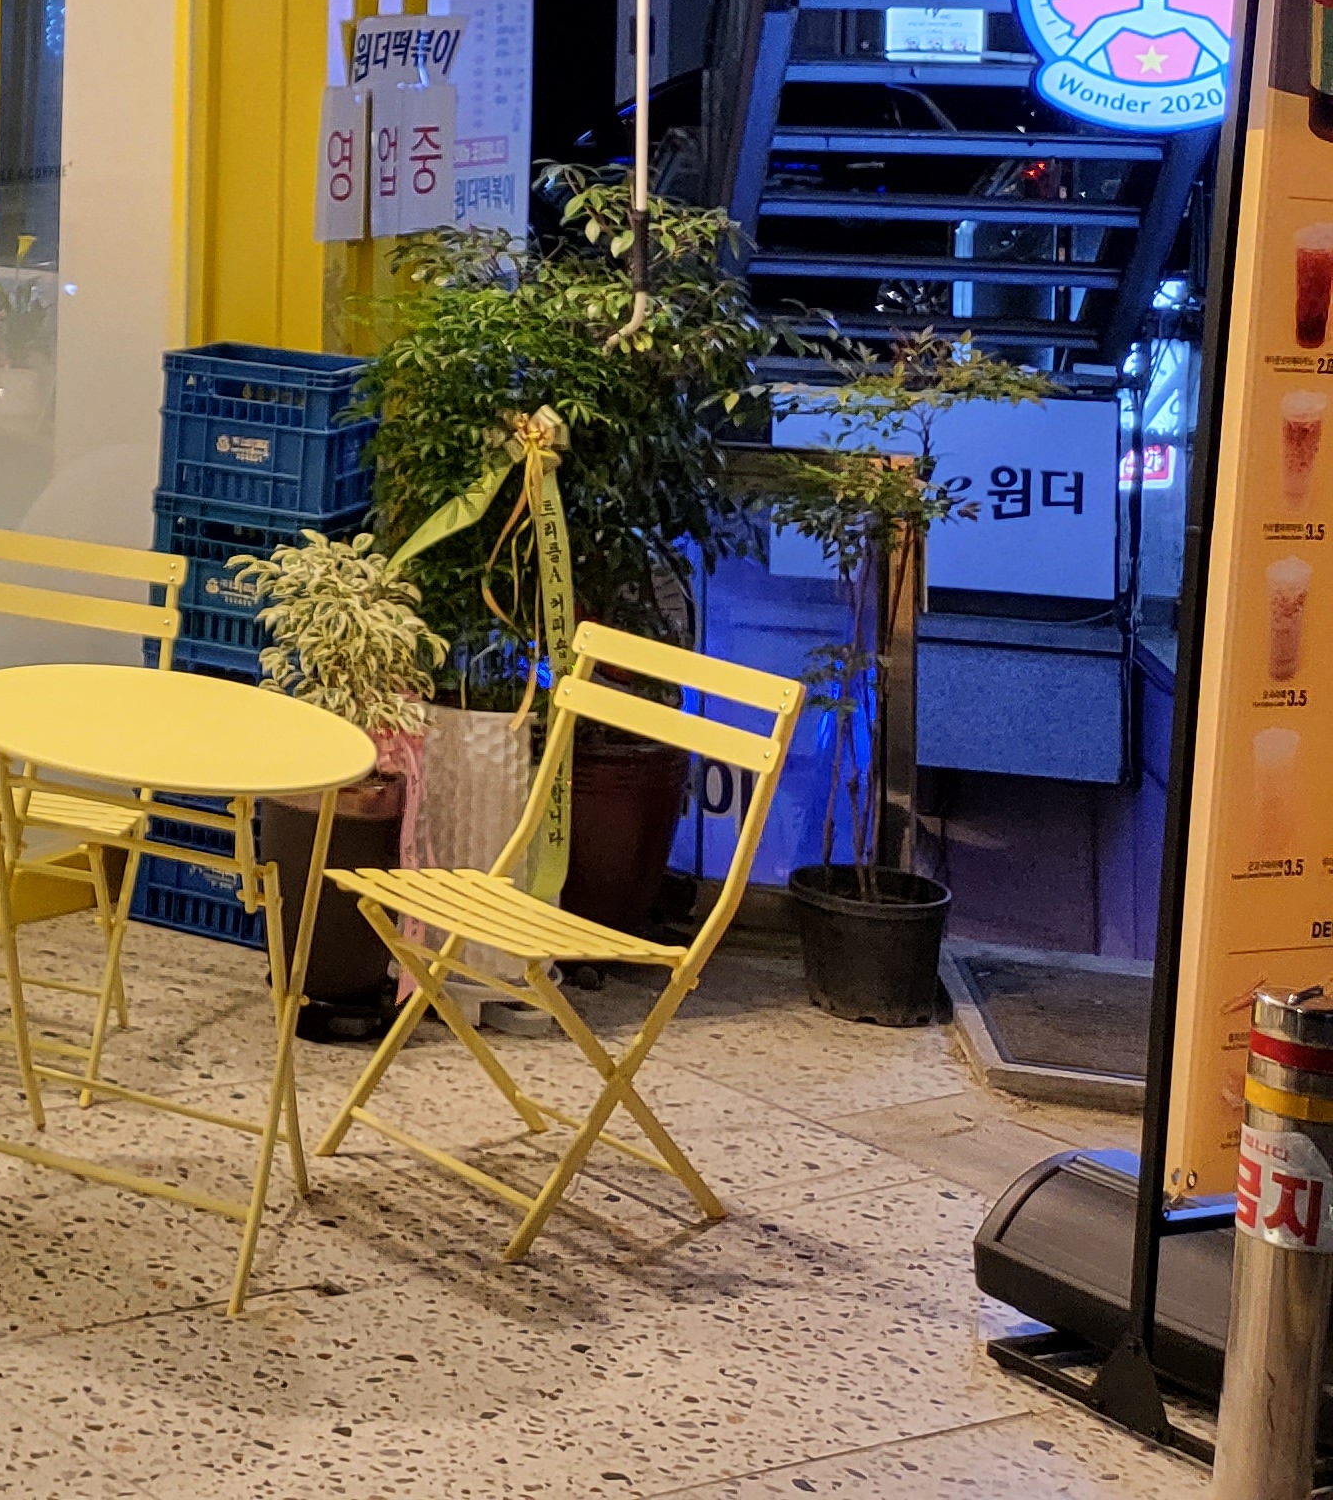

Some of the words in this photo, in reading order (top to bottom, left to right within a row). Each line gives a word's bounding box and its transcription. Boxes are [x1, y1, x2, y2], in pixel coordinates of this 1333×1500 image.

[354, 29, 461, 83] 원더떡볶이
[1059, 72, 1151, 114] Wonder
[1160, 88, 1223, 114] 2020
[327, 126, 444, 202] 영업중
[987, 465, 1084, 520] 원더
[1284, 859, 1304, 876] 3.5
